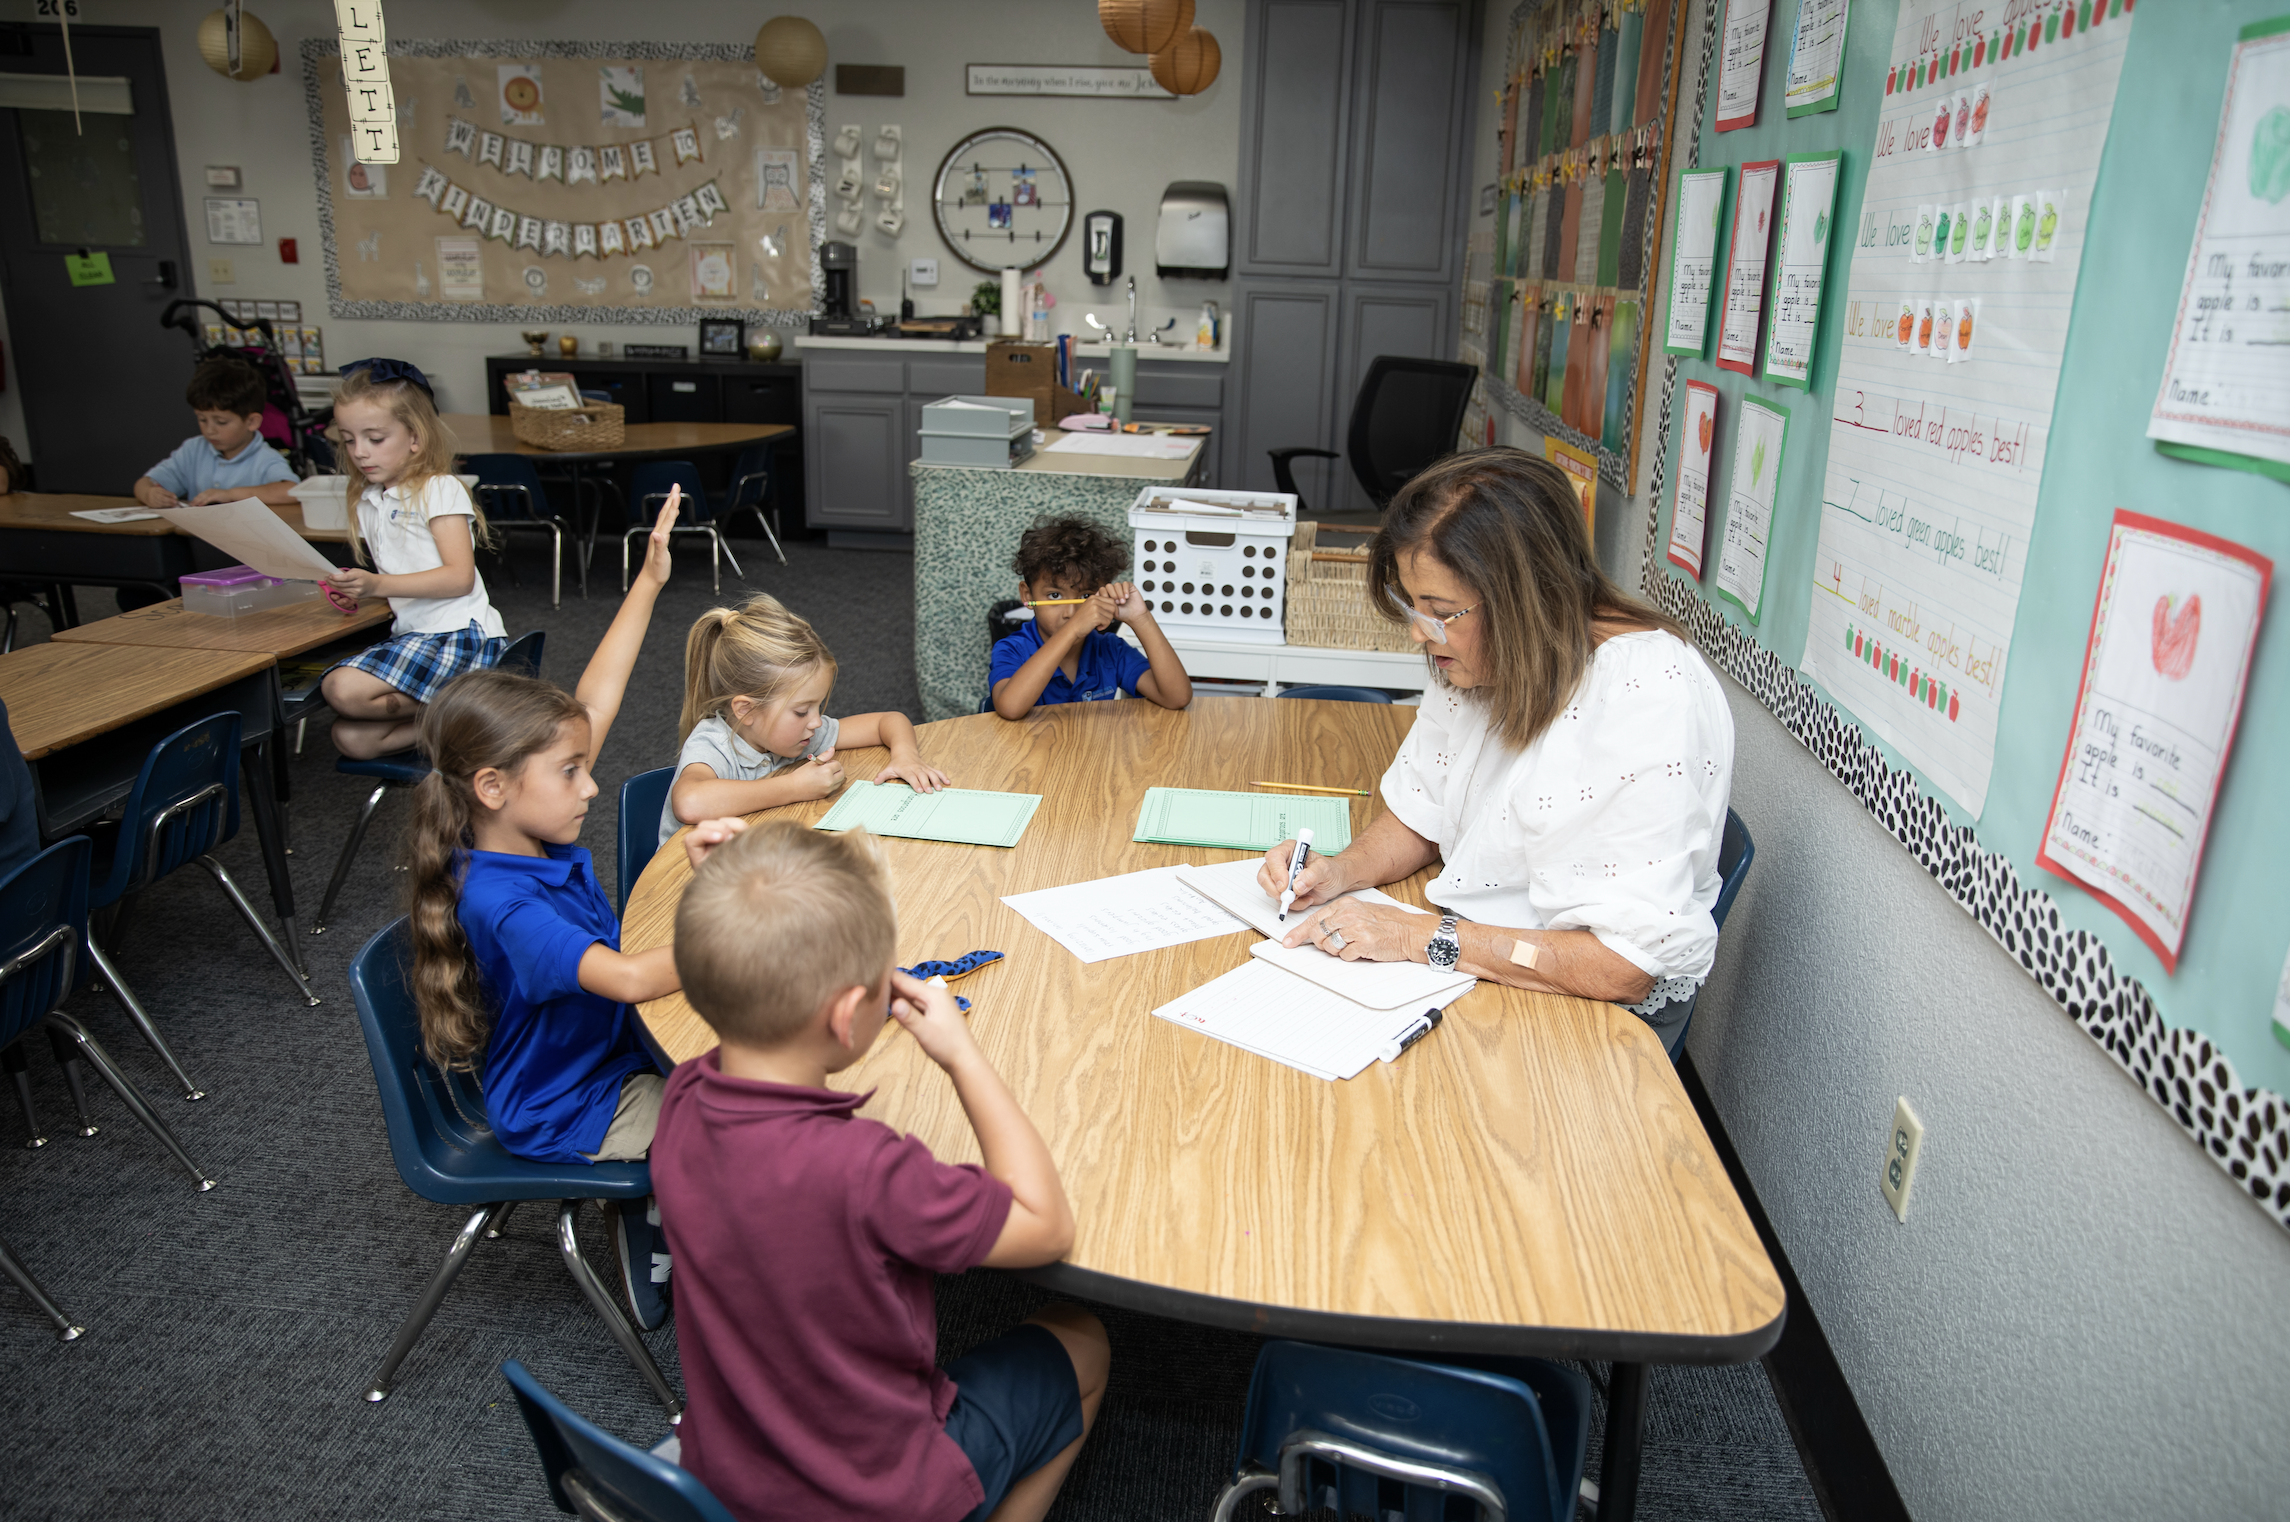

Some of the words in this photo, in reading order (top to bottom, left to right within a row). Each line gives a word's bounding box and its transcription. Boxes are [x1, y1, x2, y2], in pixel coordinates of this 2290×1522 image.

[1920, 13, 1940, 55] We
[1951, 2, 1984, 44] love
[454, 123, 648, 171] WELCOME
[676, 133, 697, 153] TO
[1877, 120, 1895, 158] We
[1903, 116, 1930, 152] love
[426, 175, 718, 248] KINDERGARTEN
[1861, 211, 1878, 247] We
[1885, 210, 1911, 247] love
[2206, 252, 2234, 289] My
[1848, 300, 1865, 338] We
[1870, 302, 1895, 339] love
[2196, 291, 2233, 325] apple
[2245, 294, 2260, 311] is
[2188, 316, 2209, 342] It
[2218, 323, 2232, 343] is
[1855, 391, 1865, 427] 3
[1893, 399, 1925, 440] loved
[1925, 406, 1946, 447] red
[1946, 412, 1984, 466] apples
[1989, 417, 2030, 473] best!
[1848, 478, 1860, 512] 7
[1875, 489, 1908, 533] loved
[1905, 516, 1931, 549] green
[1934, 516, 1965, 567] apples
[1974, 525, 2011, 581] best!
[1833, 561, 1842, 594] 4
[1858, 576, 1882, 618] loved
[1887, 601, 1920, 642] marble
[1927, 622, 1959, 670] apples
[1965, 634, 2002, 698] best!
[2093, 709, 2119, 748] My
[2130, 725, 2181, 771] favorite
[2078, 759, 2097, 788] It
[2105, 778, 2119, 798] is
[2084, 743, 2118, 776] apple
[2131, 761, 2144, 781] is
